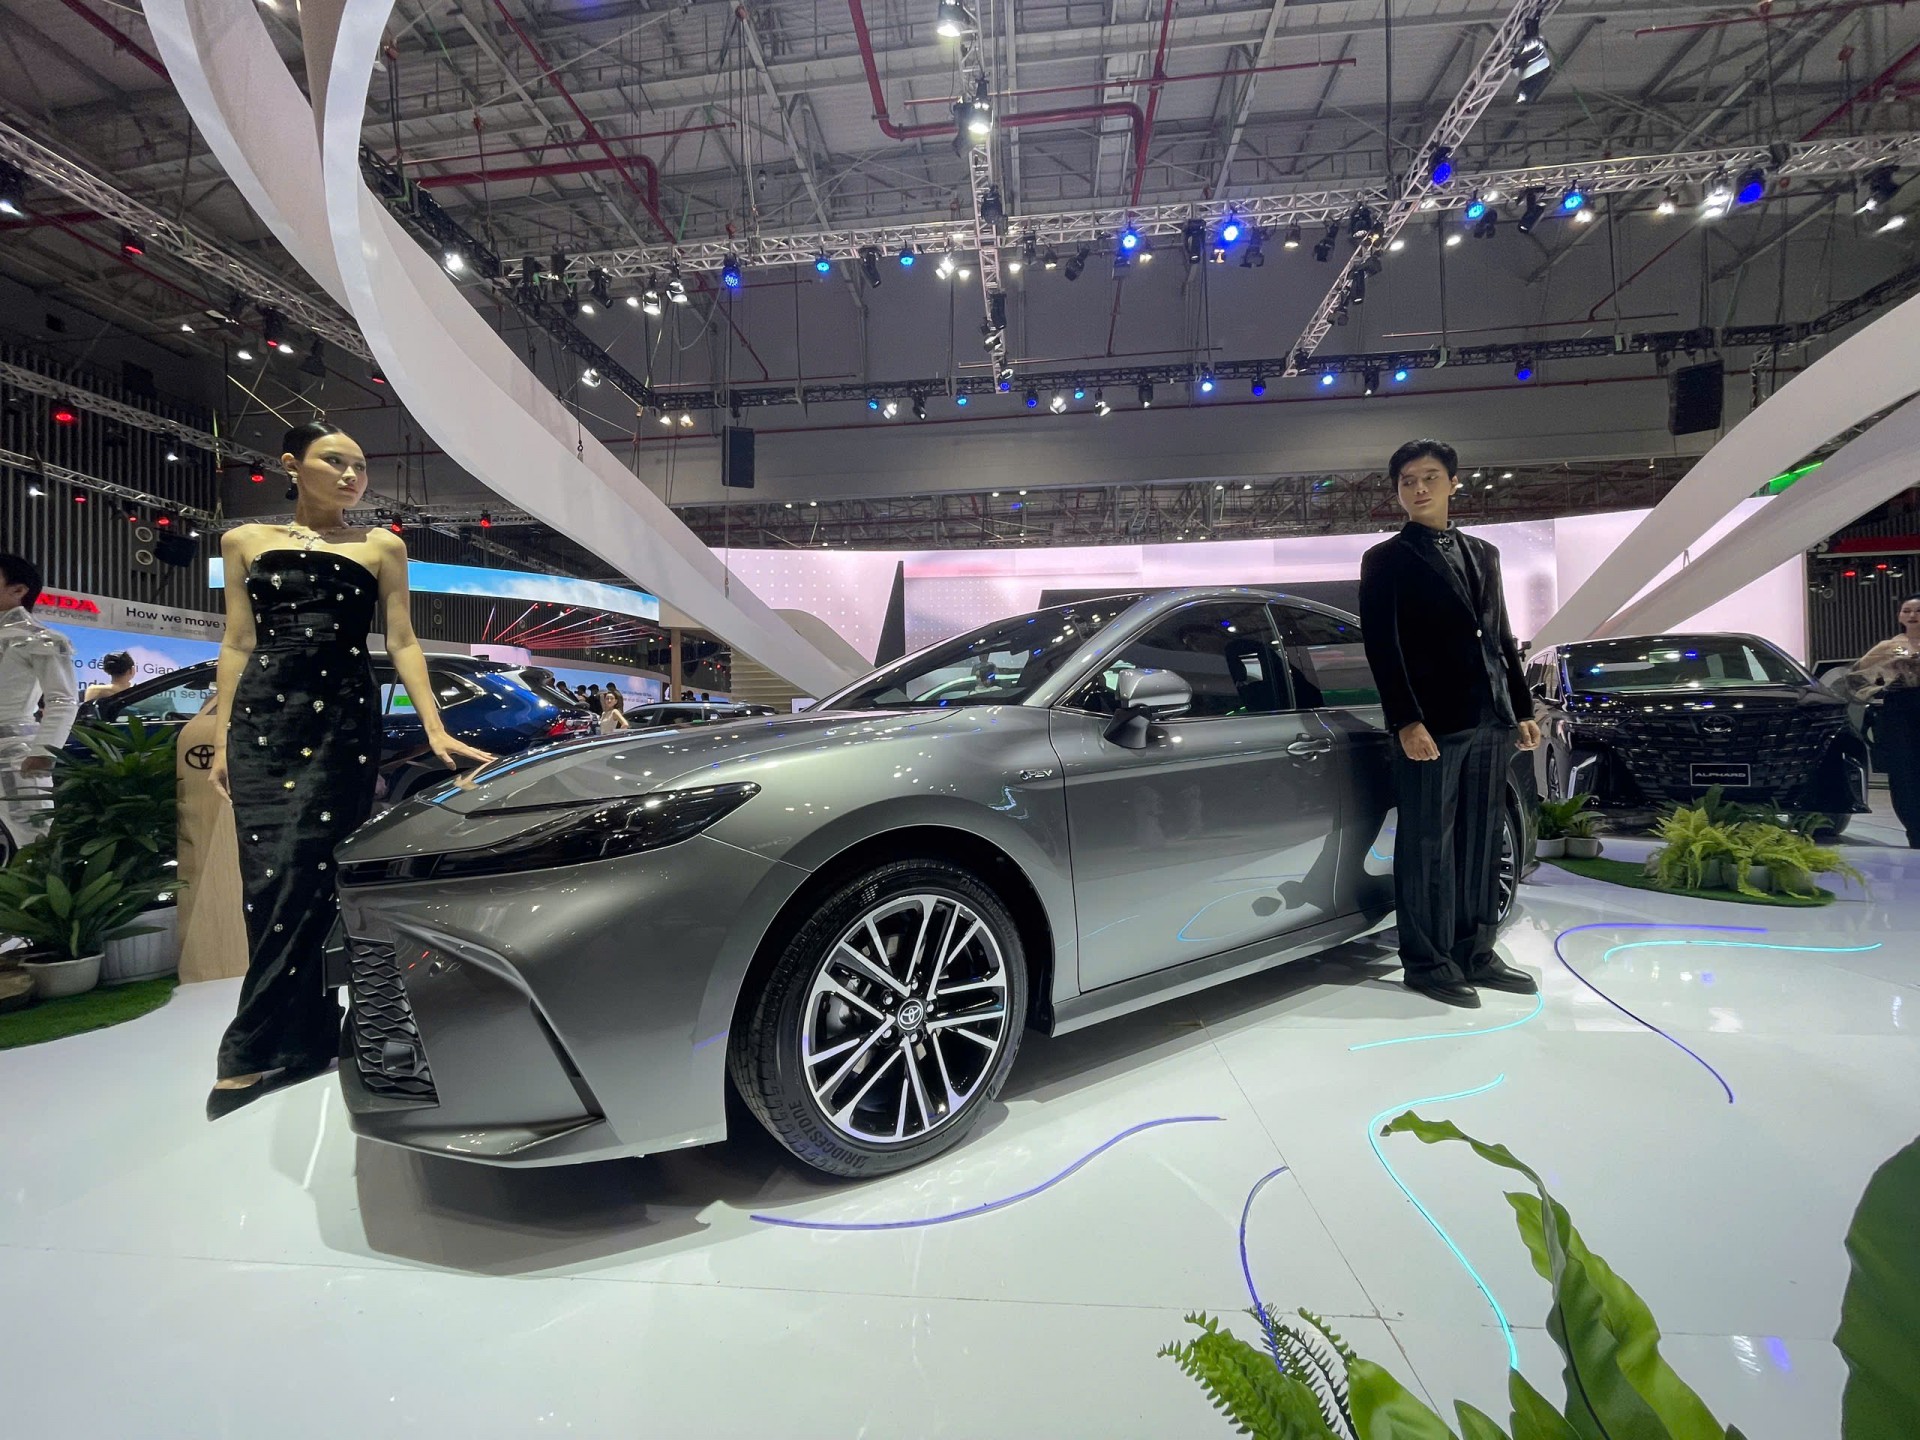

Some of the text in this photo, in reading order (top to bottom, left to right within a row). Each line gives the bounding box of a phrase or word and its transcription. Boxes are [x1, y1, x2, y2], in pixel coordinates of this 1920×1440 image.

[36, 592, 101, 614] NDA
[126, 606, 157, 620] How
[161, 612, 182, 623] we
[185, 617, 220, 629] move
[788, 1100, 871, 1169] BRIDGESTONE
